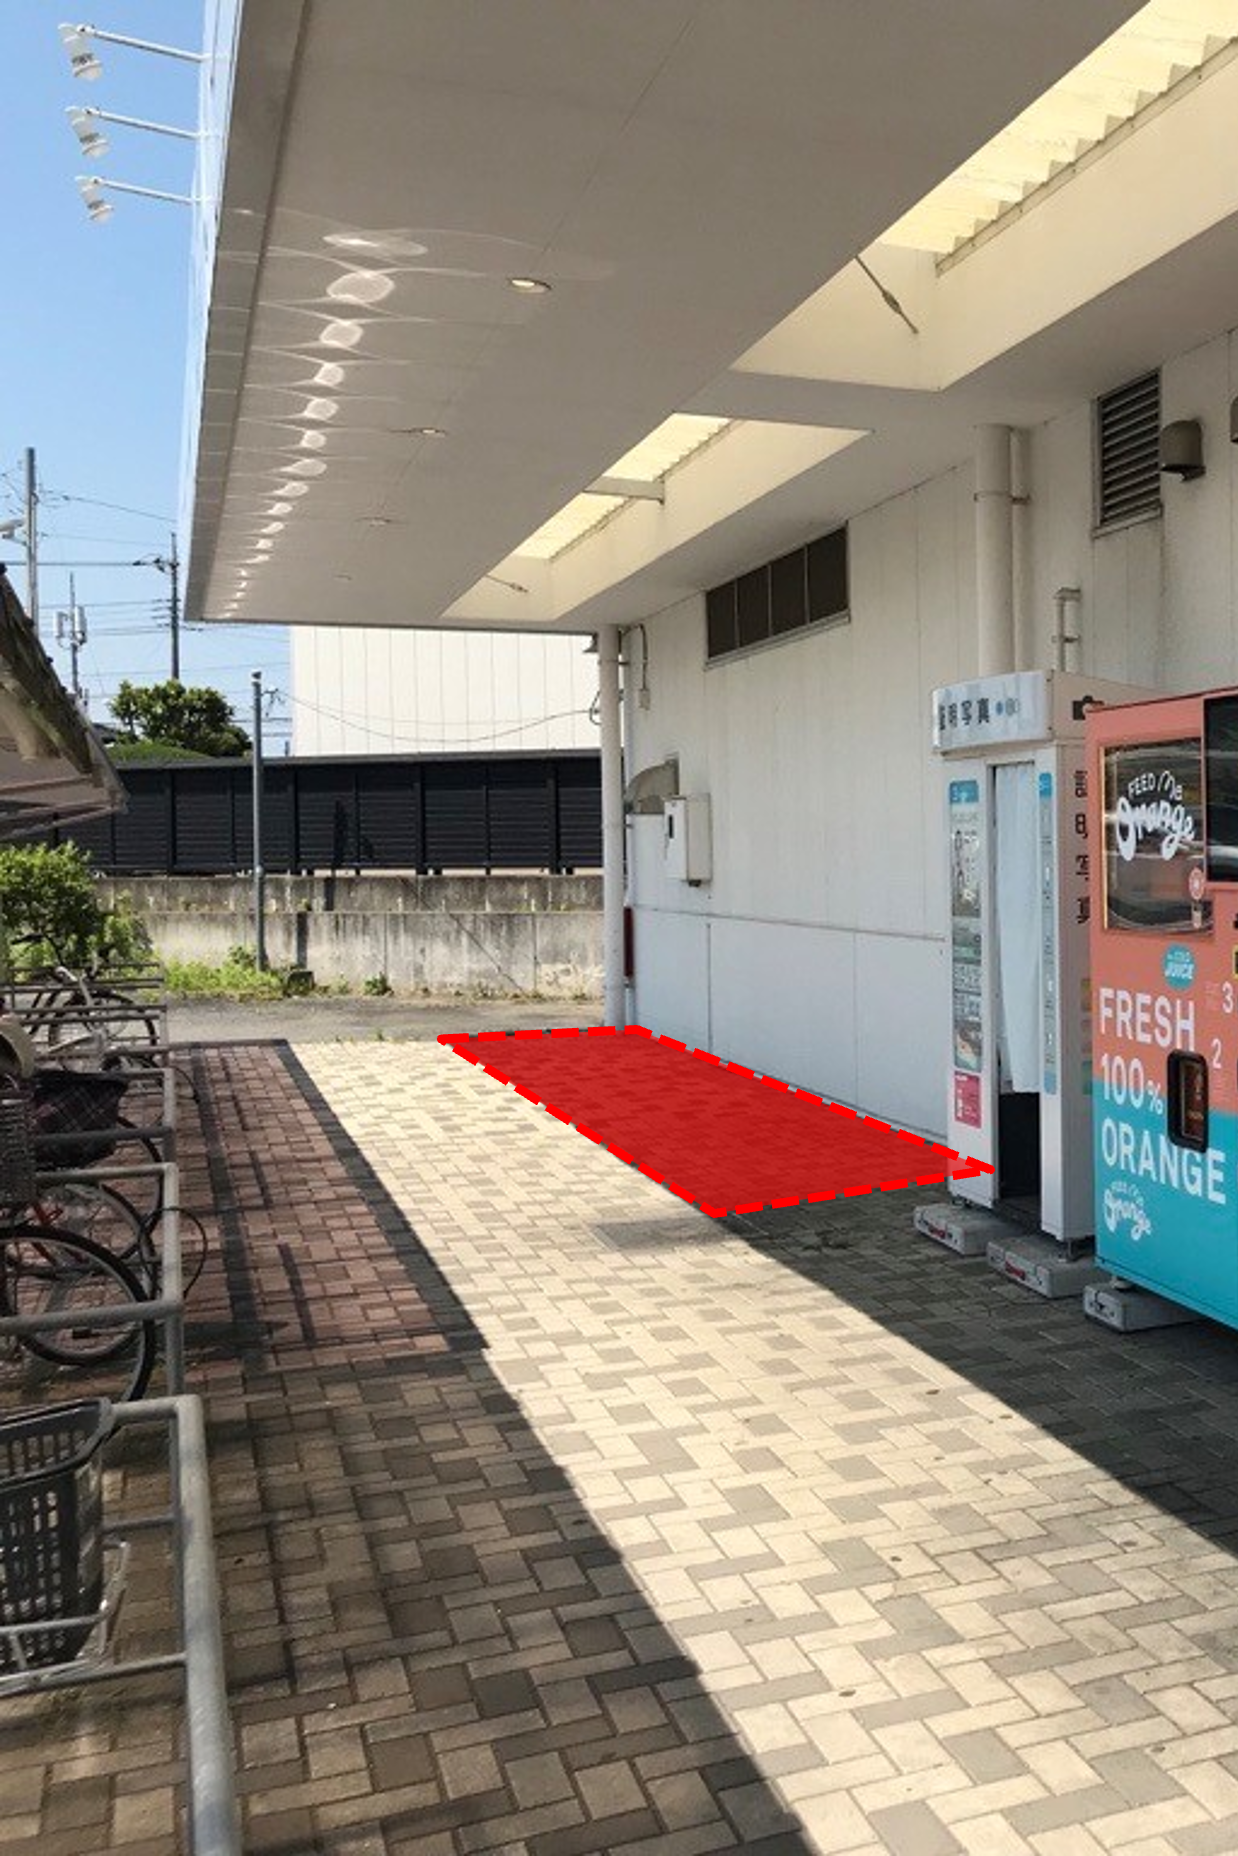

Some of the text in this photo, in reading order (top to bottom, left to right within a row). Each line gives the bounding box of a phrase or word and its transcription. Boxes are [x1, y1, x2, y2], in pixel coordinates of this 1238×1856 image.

[1127, 772, 1155, 800] FEED
[1100, 986, 1196, 1052] FRESH
[1221, 980, 1235, 1015] 3
[1211, 1037, 1222, 1070] 2
[1100, 1052, 1164, 1116] 100%
[1101, 1116, 1227, 1205] ORANGE
